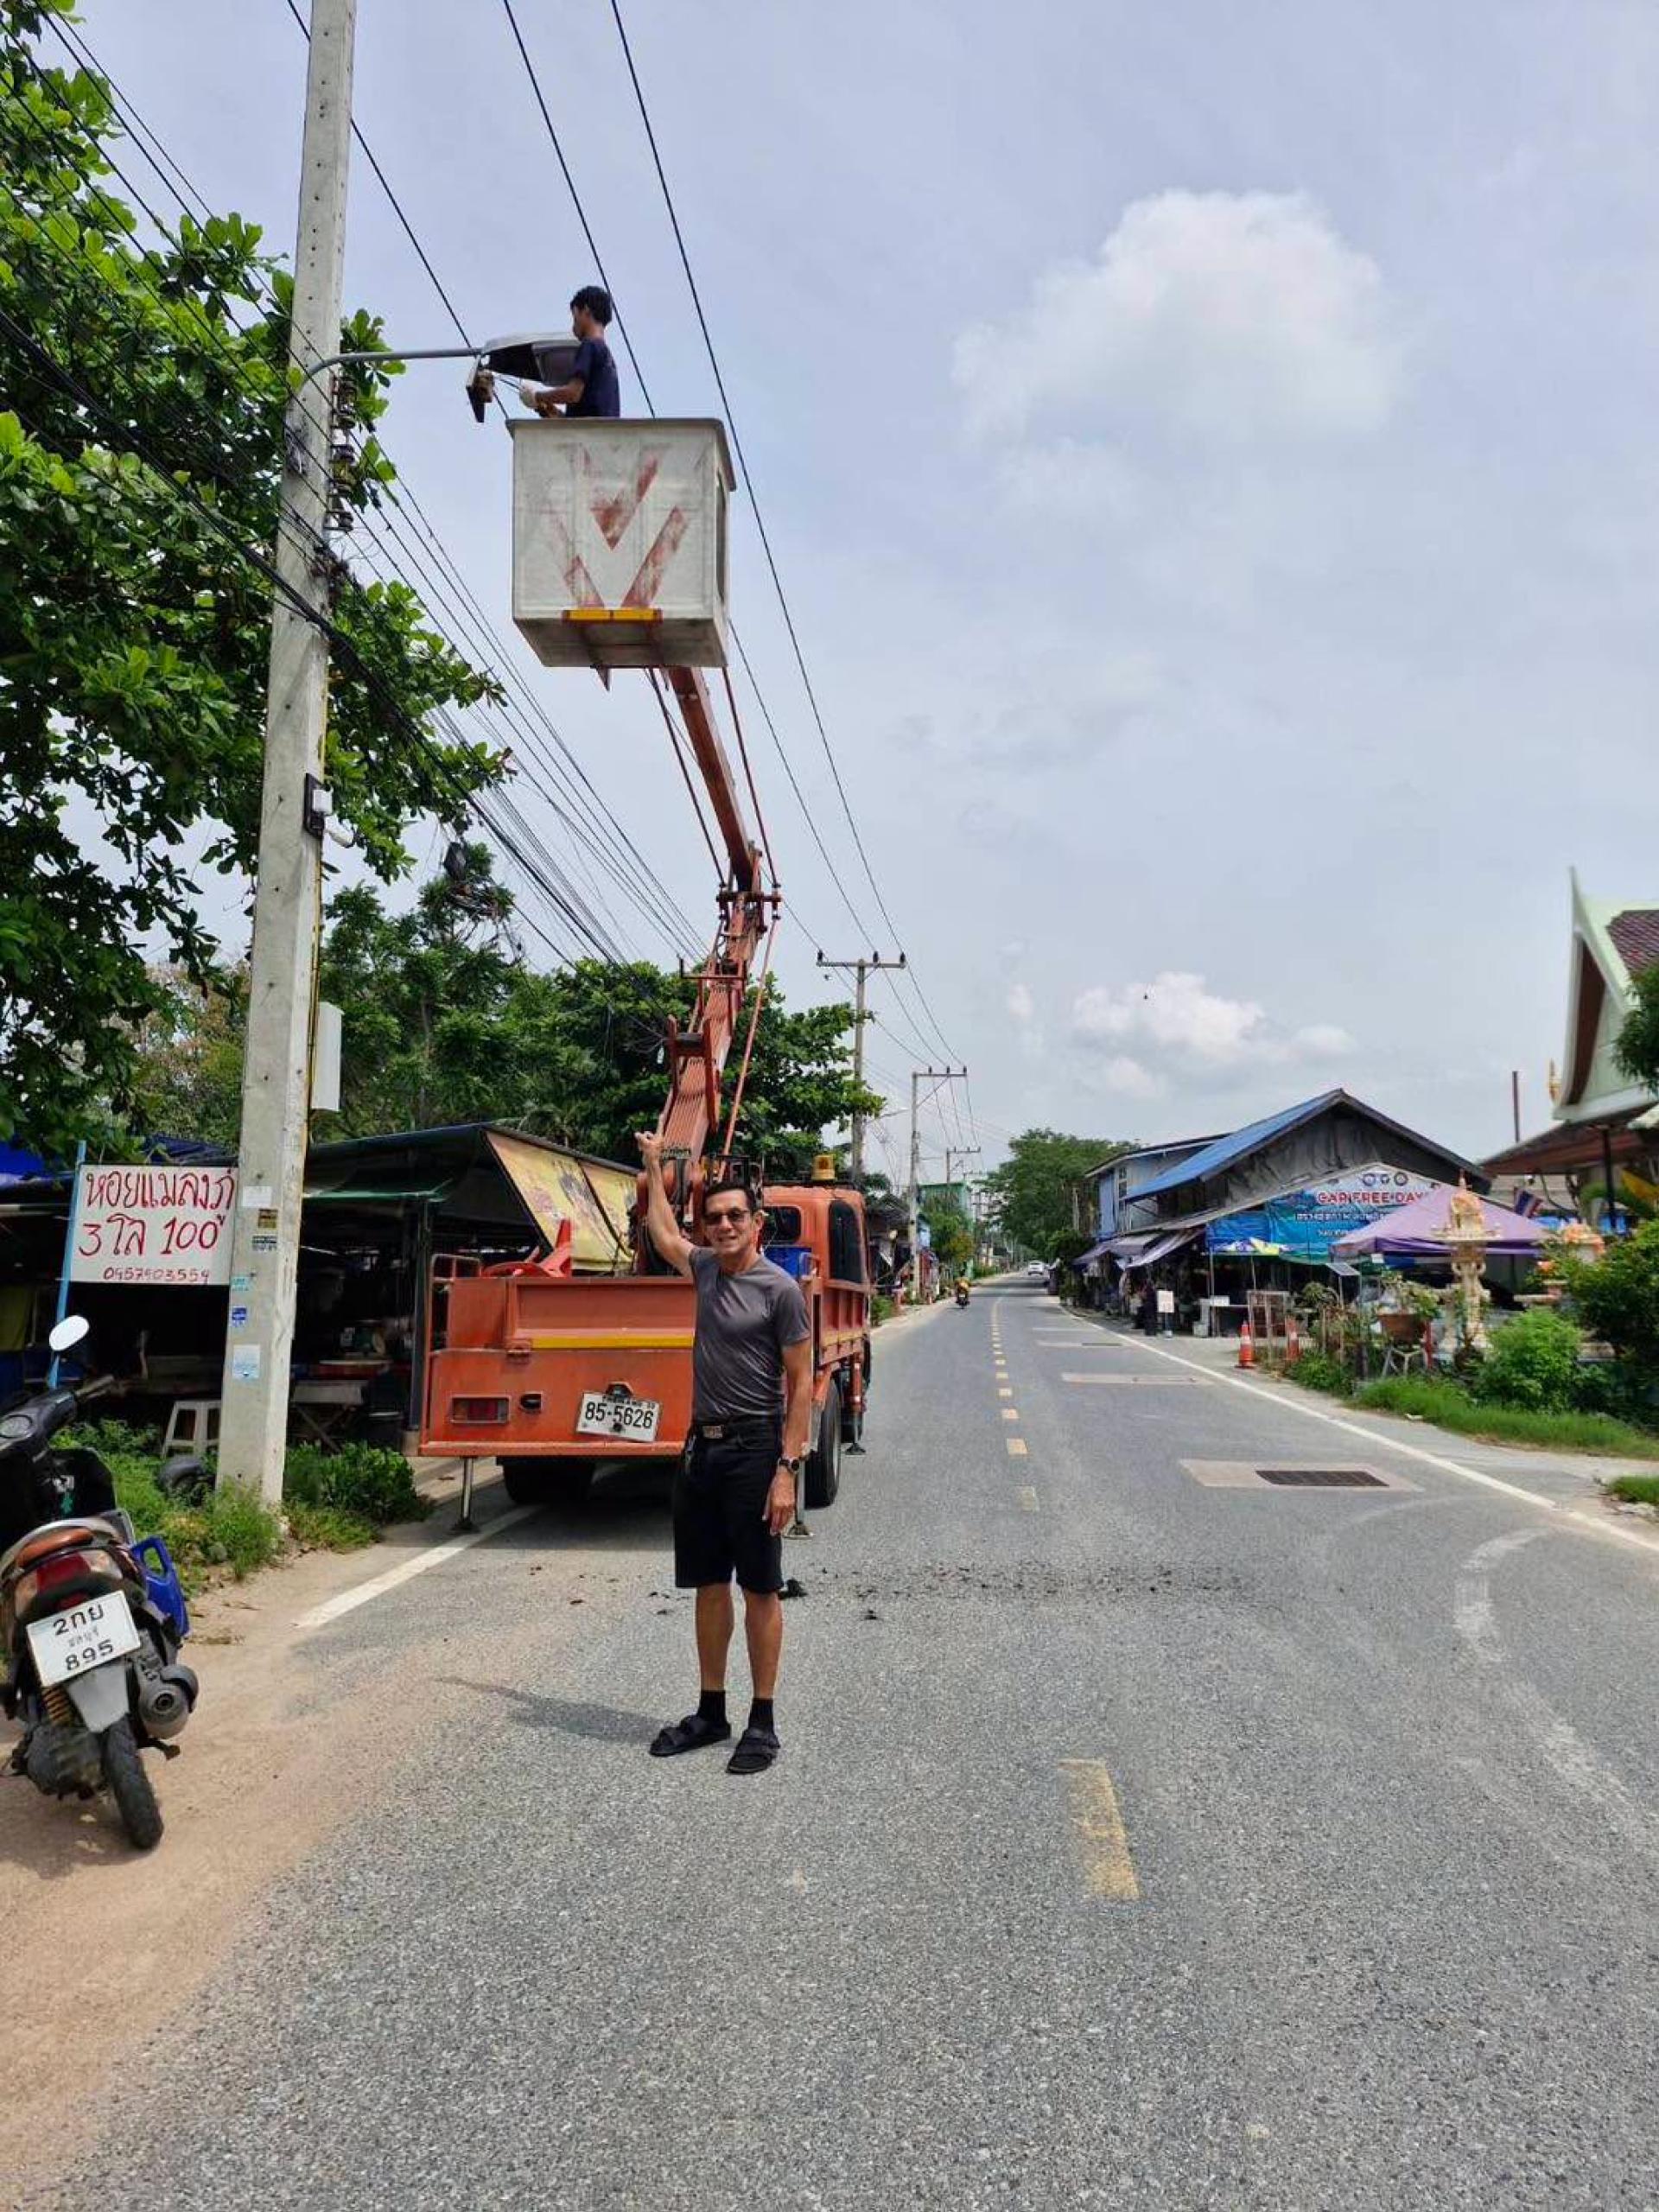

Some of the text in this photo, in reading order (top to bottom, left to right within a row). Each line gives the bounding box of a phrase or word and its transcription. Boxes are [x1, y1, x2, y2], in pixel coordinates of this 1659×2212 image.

[1353, 1192, 1389, 1204] FREE
[1395, 1192, 1424, 1204] DAY
[66, 1639, 113, 1670] 895
